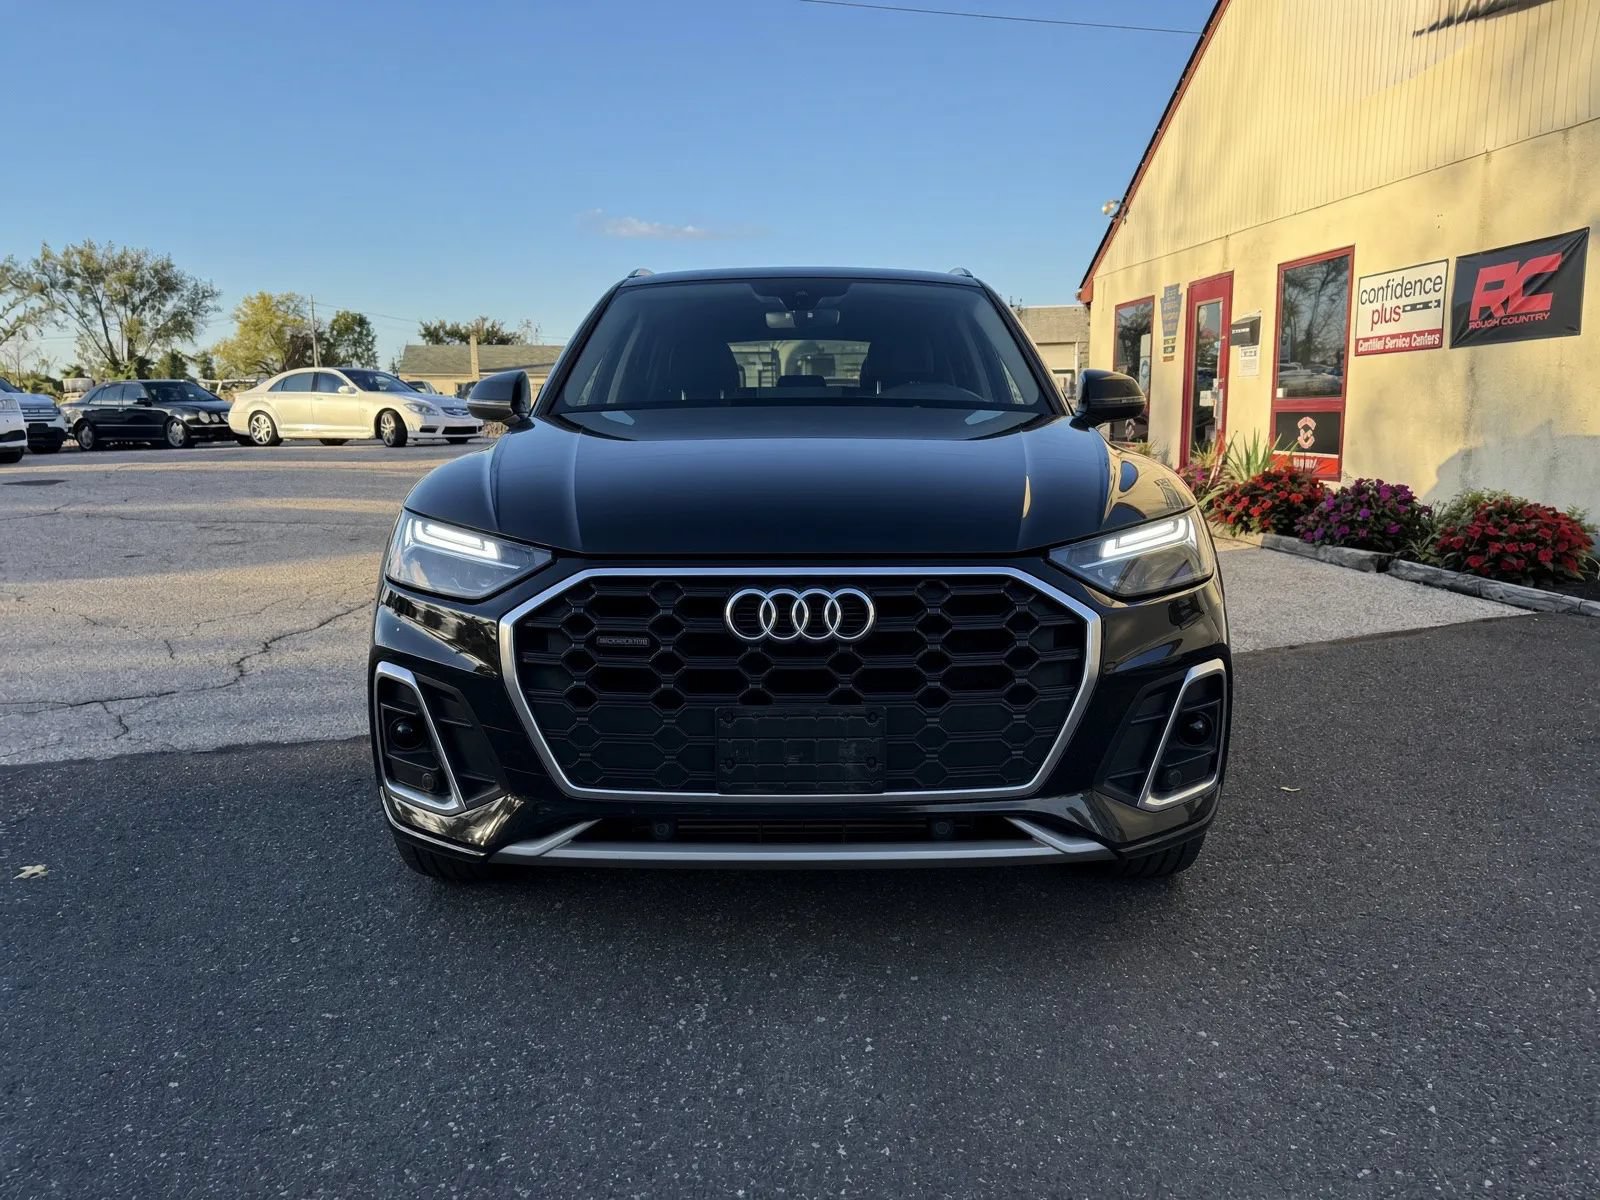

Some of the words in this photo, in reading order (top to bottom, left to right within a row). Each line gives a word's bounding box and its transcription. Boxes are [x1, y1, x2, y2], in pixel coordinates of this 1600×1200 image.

[1360, 275, 1443, 305] confidence
[1469, 252, 1562, 321] RC
[1370, 303, 1402, 331] plus
[1469, 318, 1500, 329] ROUGH
[1501, 312, 1550, 325] COUNTRY
[1385, 335, 1410, 349] Service
[1411, 332, 1440, 347] Centers
